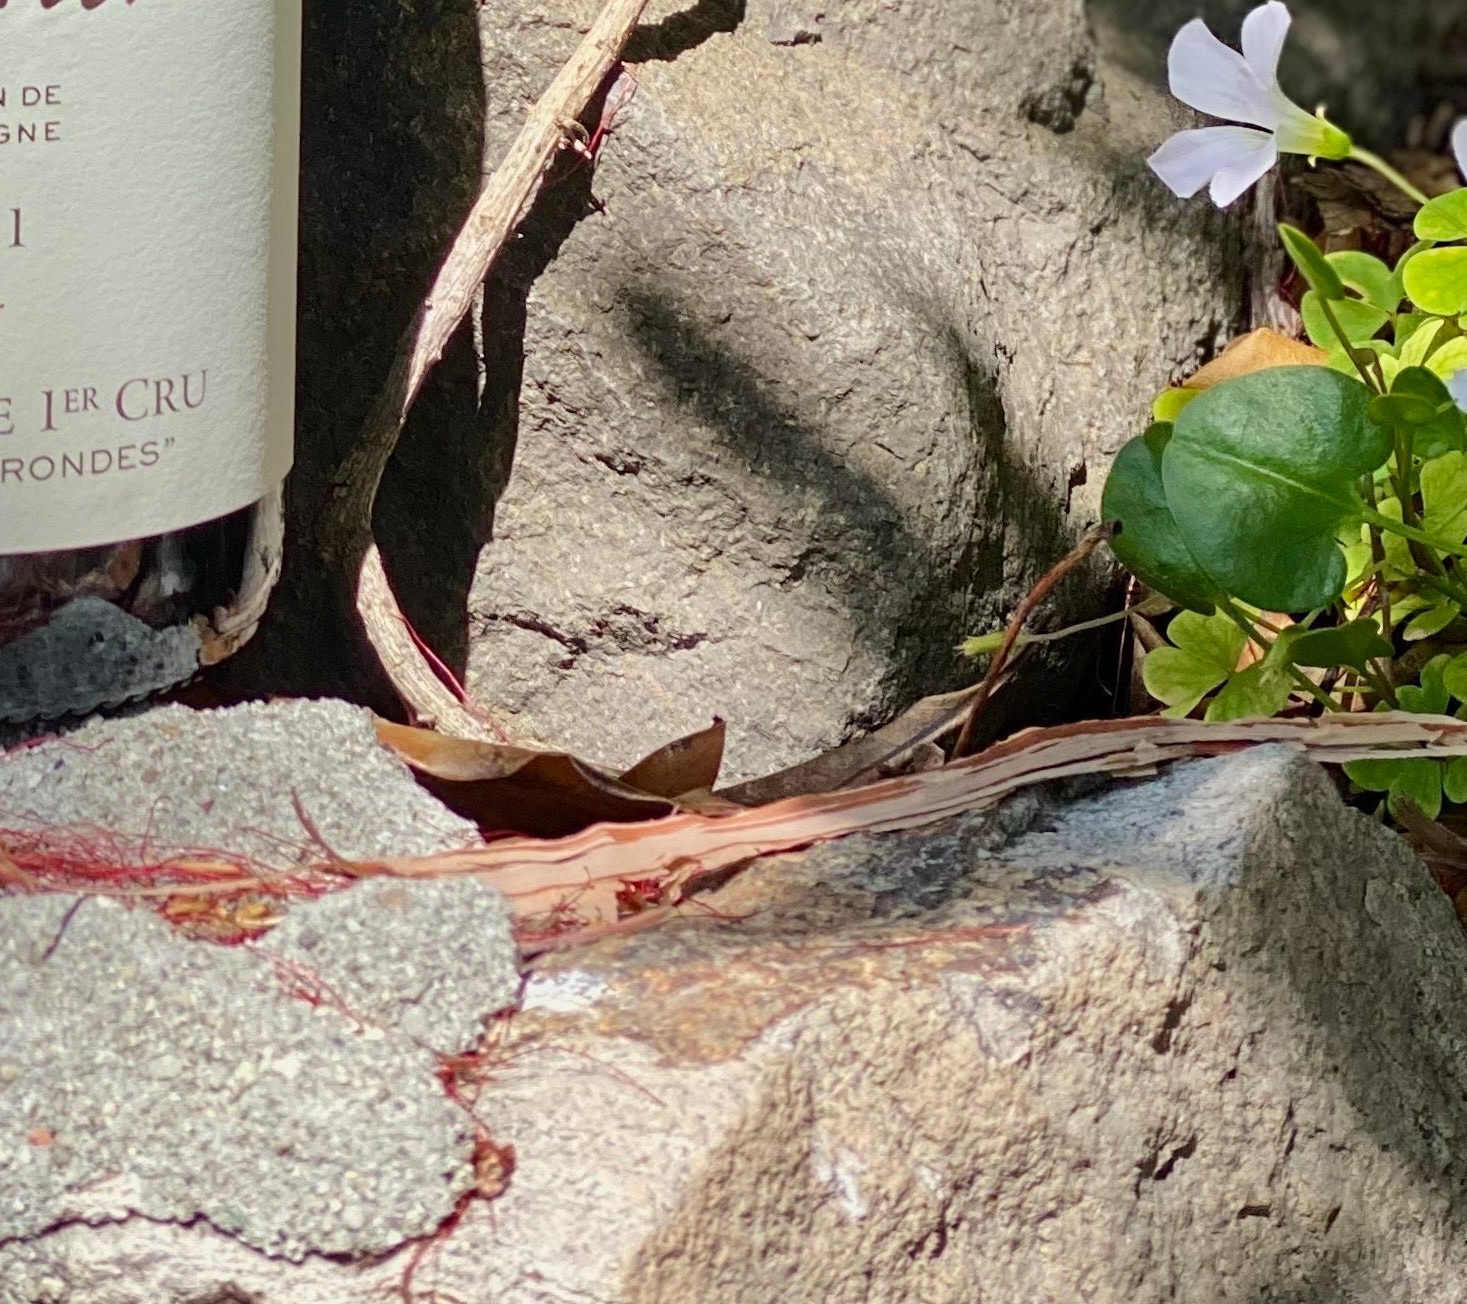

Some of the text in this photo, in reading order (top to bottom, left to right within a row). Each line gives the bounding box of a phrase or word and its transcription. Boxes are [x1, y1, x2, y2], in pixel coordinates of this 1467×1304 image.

[21, 85, 62, 107] DE
[39, 386, 100, 432] 1ER
[115, 370, 211, 423] CRU
[1, 437, 176, 484] RONDES”
